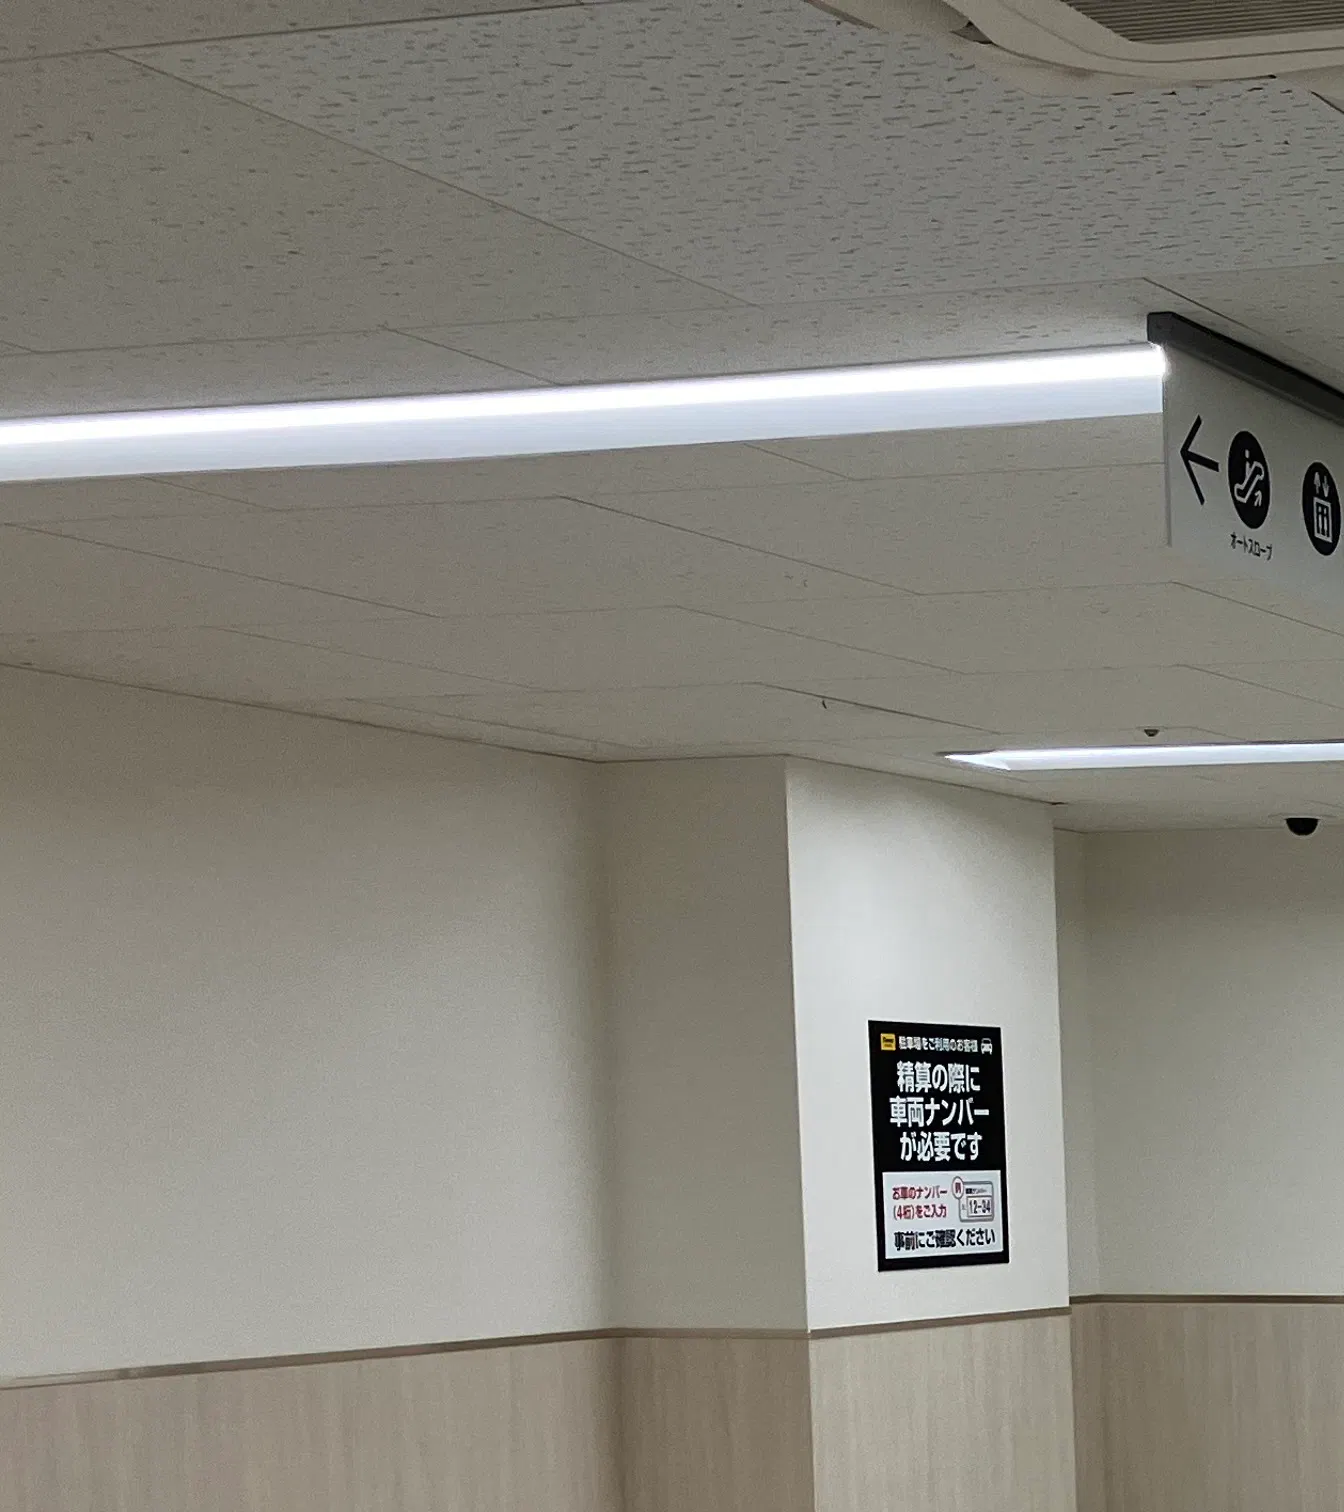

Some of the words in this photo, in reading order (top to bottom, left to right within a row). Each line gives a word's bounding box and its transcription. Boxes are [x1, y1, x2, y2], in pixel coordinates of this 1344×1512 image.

[1230, 532, 1272, 561] オートスロープ
[896, 1060, 981, 1094] 精算の際に
[889, 1096, 990, 1128] 車両ナンバー
[899, 1131, 983, 1162] が必要です
[892, 1185, 948, 1200] お車のナンバー
[968, 1199, 992, 1214] 12-34
[894, 1227, 996, 1251] 事前にご確認ください
